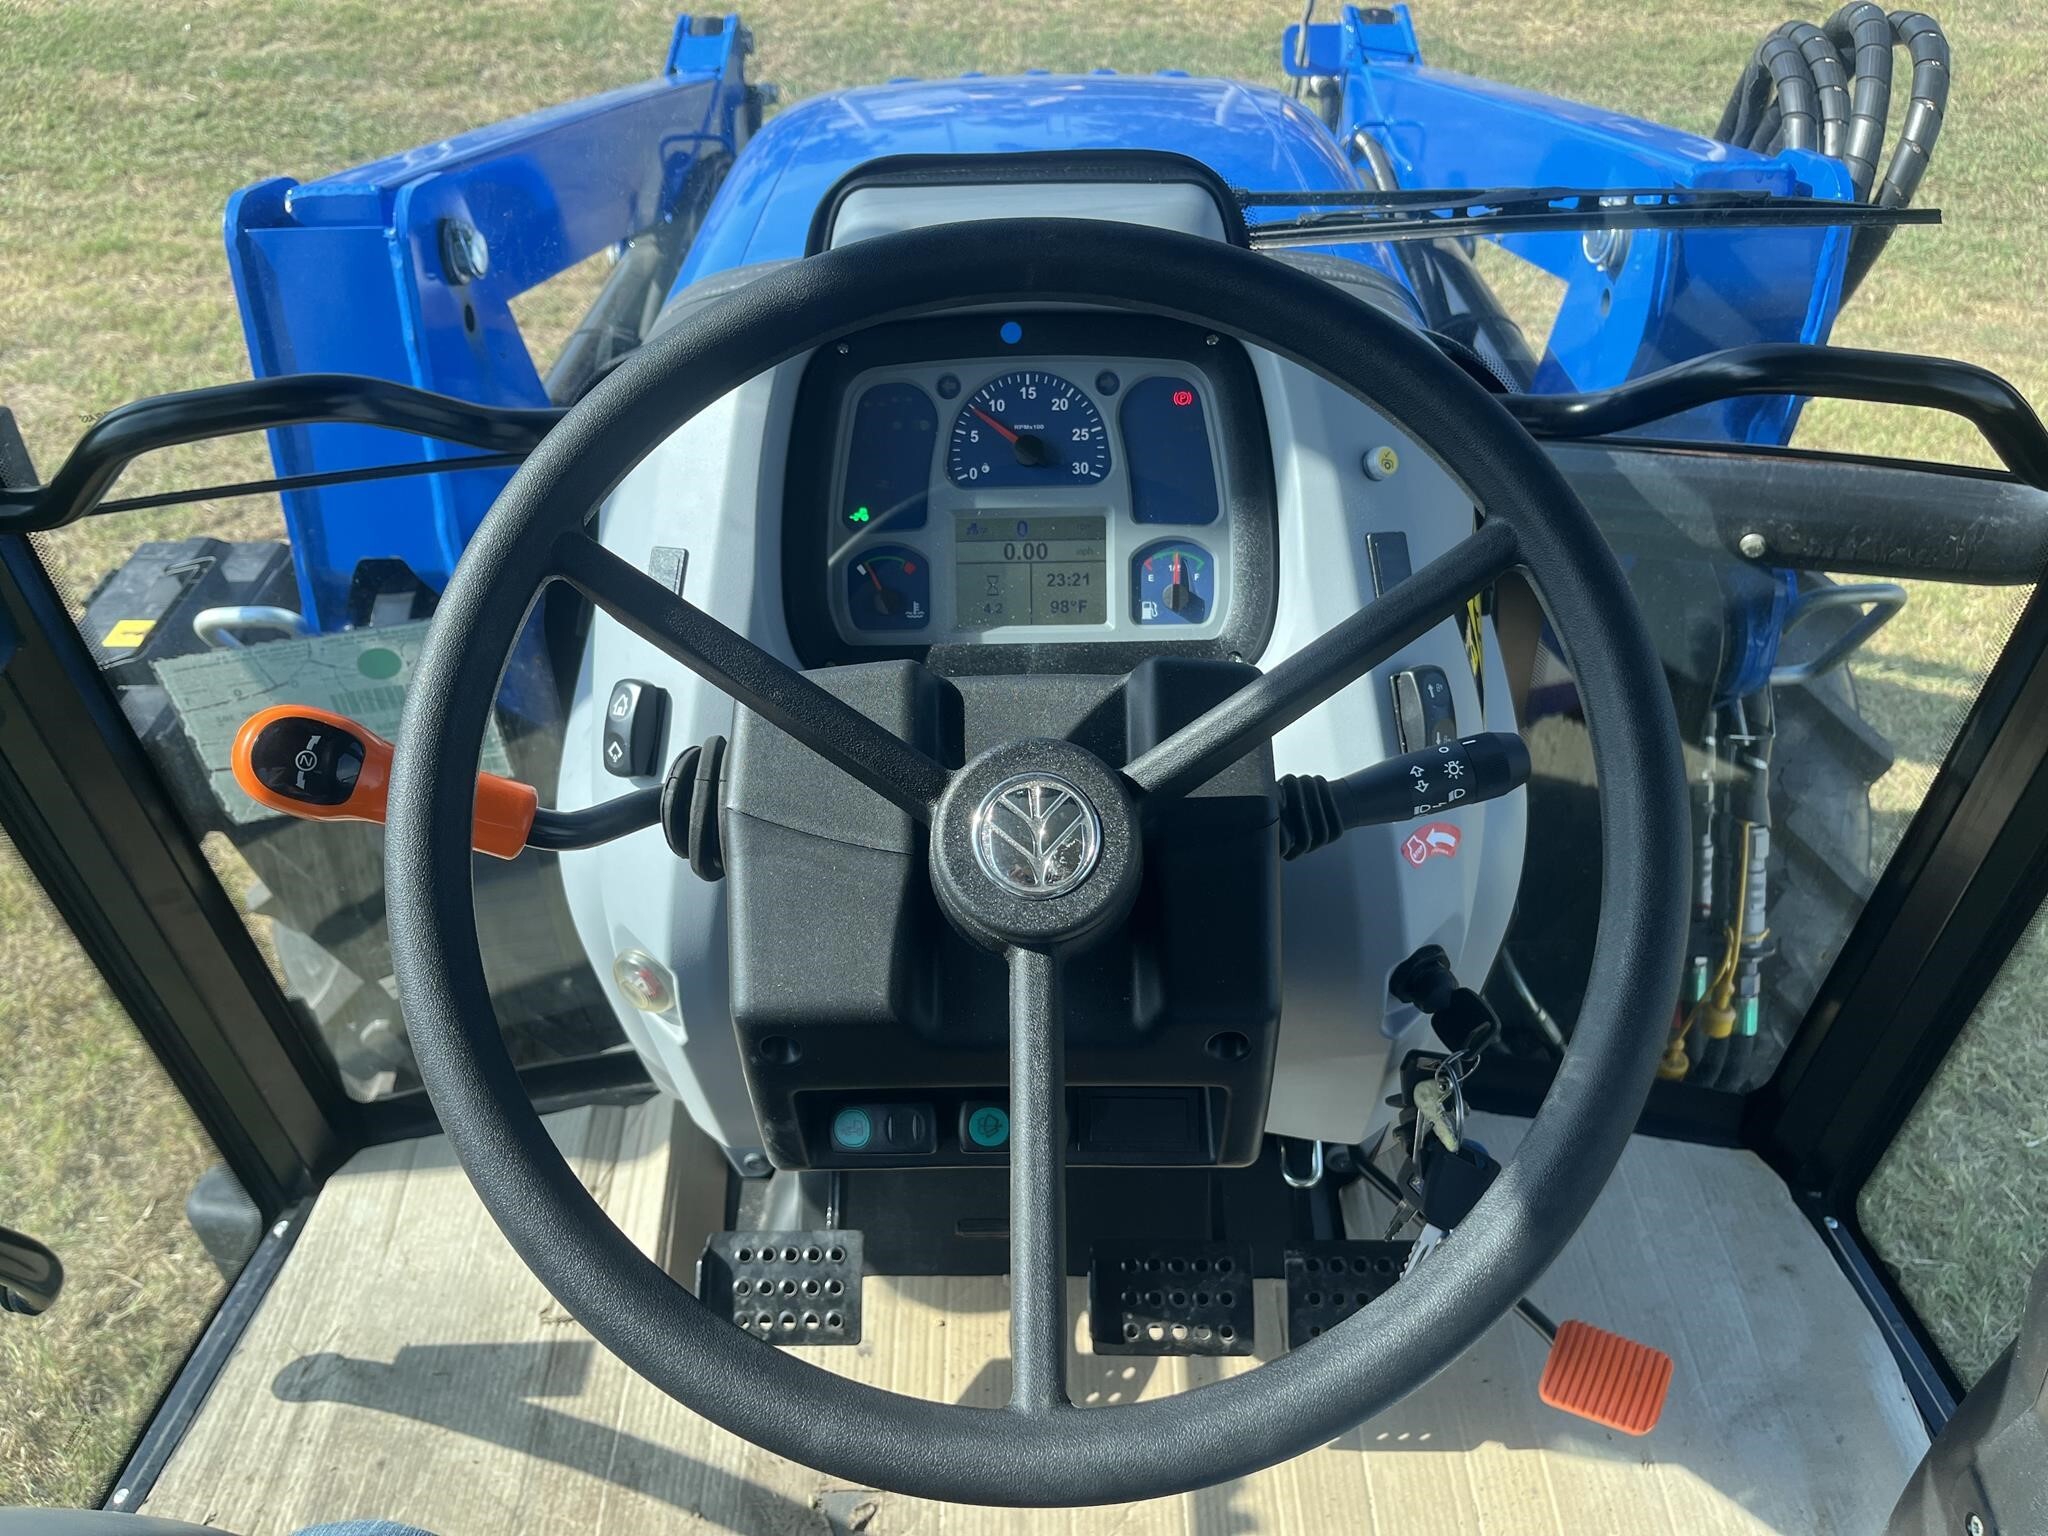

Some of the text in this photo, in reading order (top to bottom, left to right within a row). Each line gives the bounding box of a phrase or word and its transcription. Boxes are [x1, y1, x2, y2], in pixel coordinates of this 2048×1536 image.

[1020, 386, 1037, 400] 15
[989, 399, 1006, 412] 10
[1051, 398, 1069, 411] 20
[970, 430, 979, 443] 5
[1072, 428, 1089, 441] 25
[969, 468, 978, 480] 0
[1072, 462, 1089, 474] 30
[1016, 520, 1028, 538] 0
[1003, 542, 1048, 560] 0.00
[1046, 572, 1090, 587] 23:21
[1147, 574, 1155, 582] E
[1194, 573, 1200, 581] F
[1049, 599, 1088, 614] 98°F
